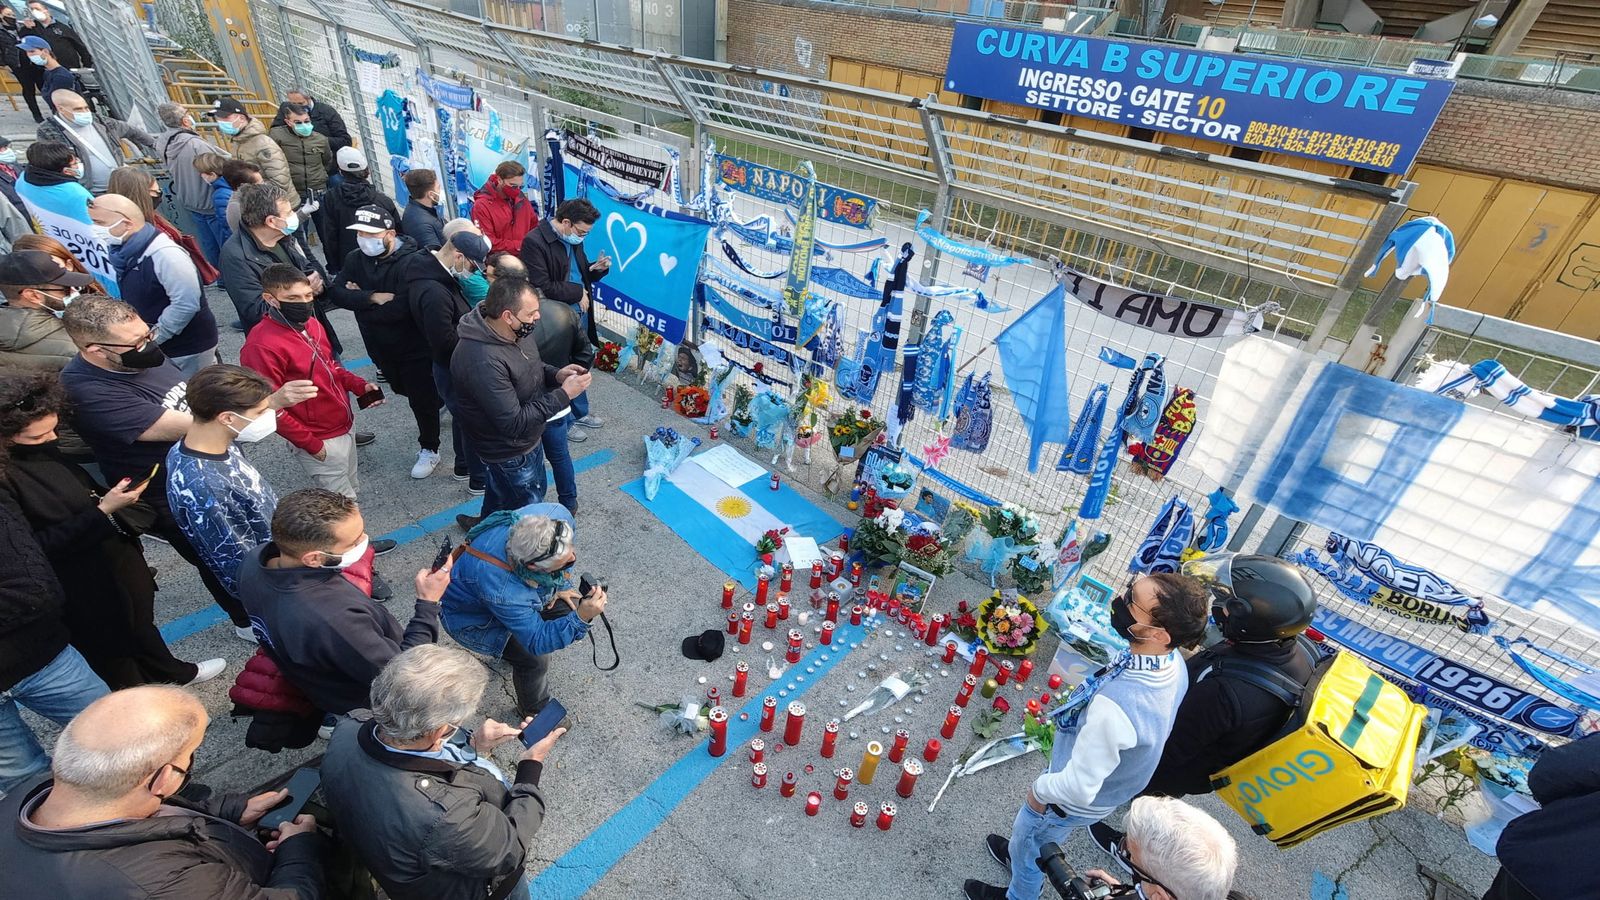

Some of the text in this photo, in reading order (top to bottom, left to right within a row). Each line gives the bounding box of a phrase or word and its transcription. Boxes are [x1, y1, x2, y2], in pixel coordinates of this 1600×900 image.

[976, 28, 1427, 115] CURVA B SUPERIORE
[1018, 67, 1122, 102] INGRESSO
[1130, 85, 1194, 115] GATE
[1196, 96, 1226, 120] 10
[382, 104, 399, 131] 10
[1025, 90, 1122, 120] SETTORE
[1140, 109, 1241, 141] SECTOR
[626, 161, 663, 181] DIMENTICA
[752, 167, 828, 208] NAPOI
[613, 297, 667, 333] CUORE
[740, 313, 795, 341] NAPOL
[1067, 271, 1224, 337] TI AMO
[1377, 603, 1412, 621] PAOLO
[1337, 617, 1435, 673] NAPOLI
[1420, 658, 1522, 709] 1926
[1238, 750, 1335, 804] Glovo
